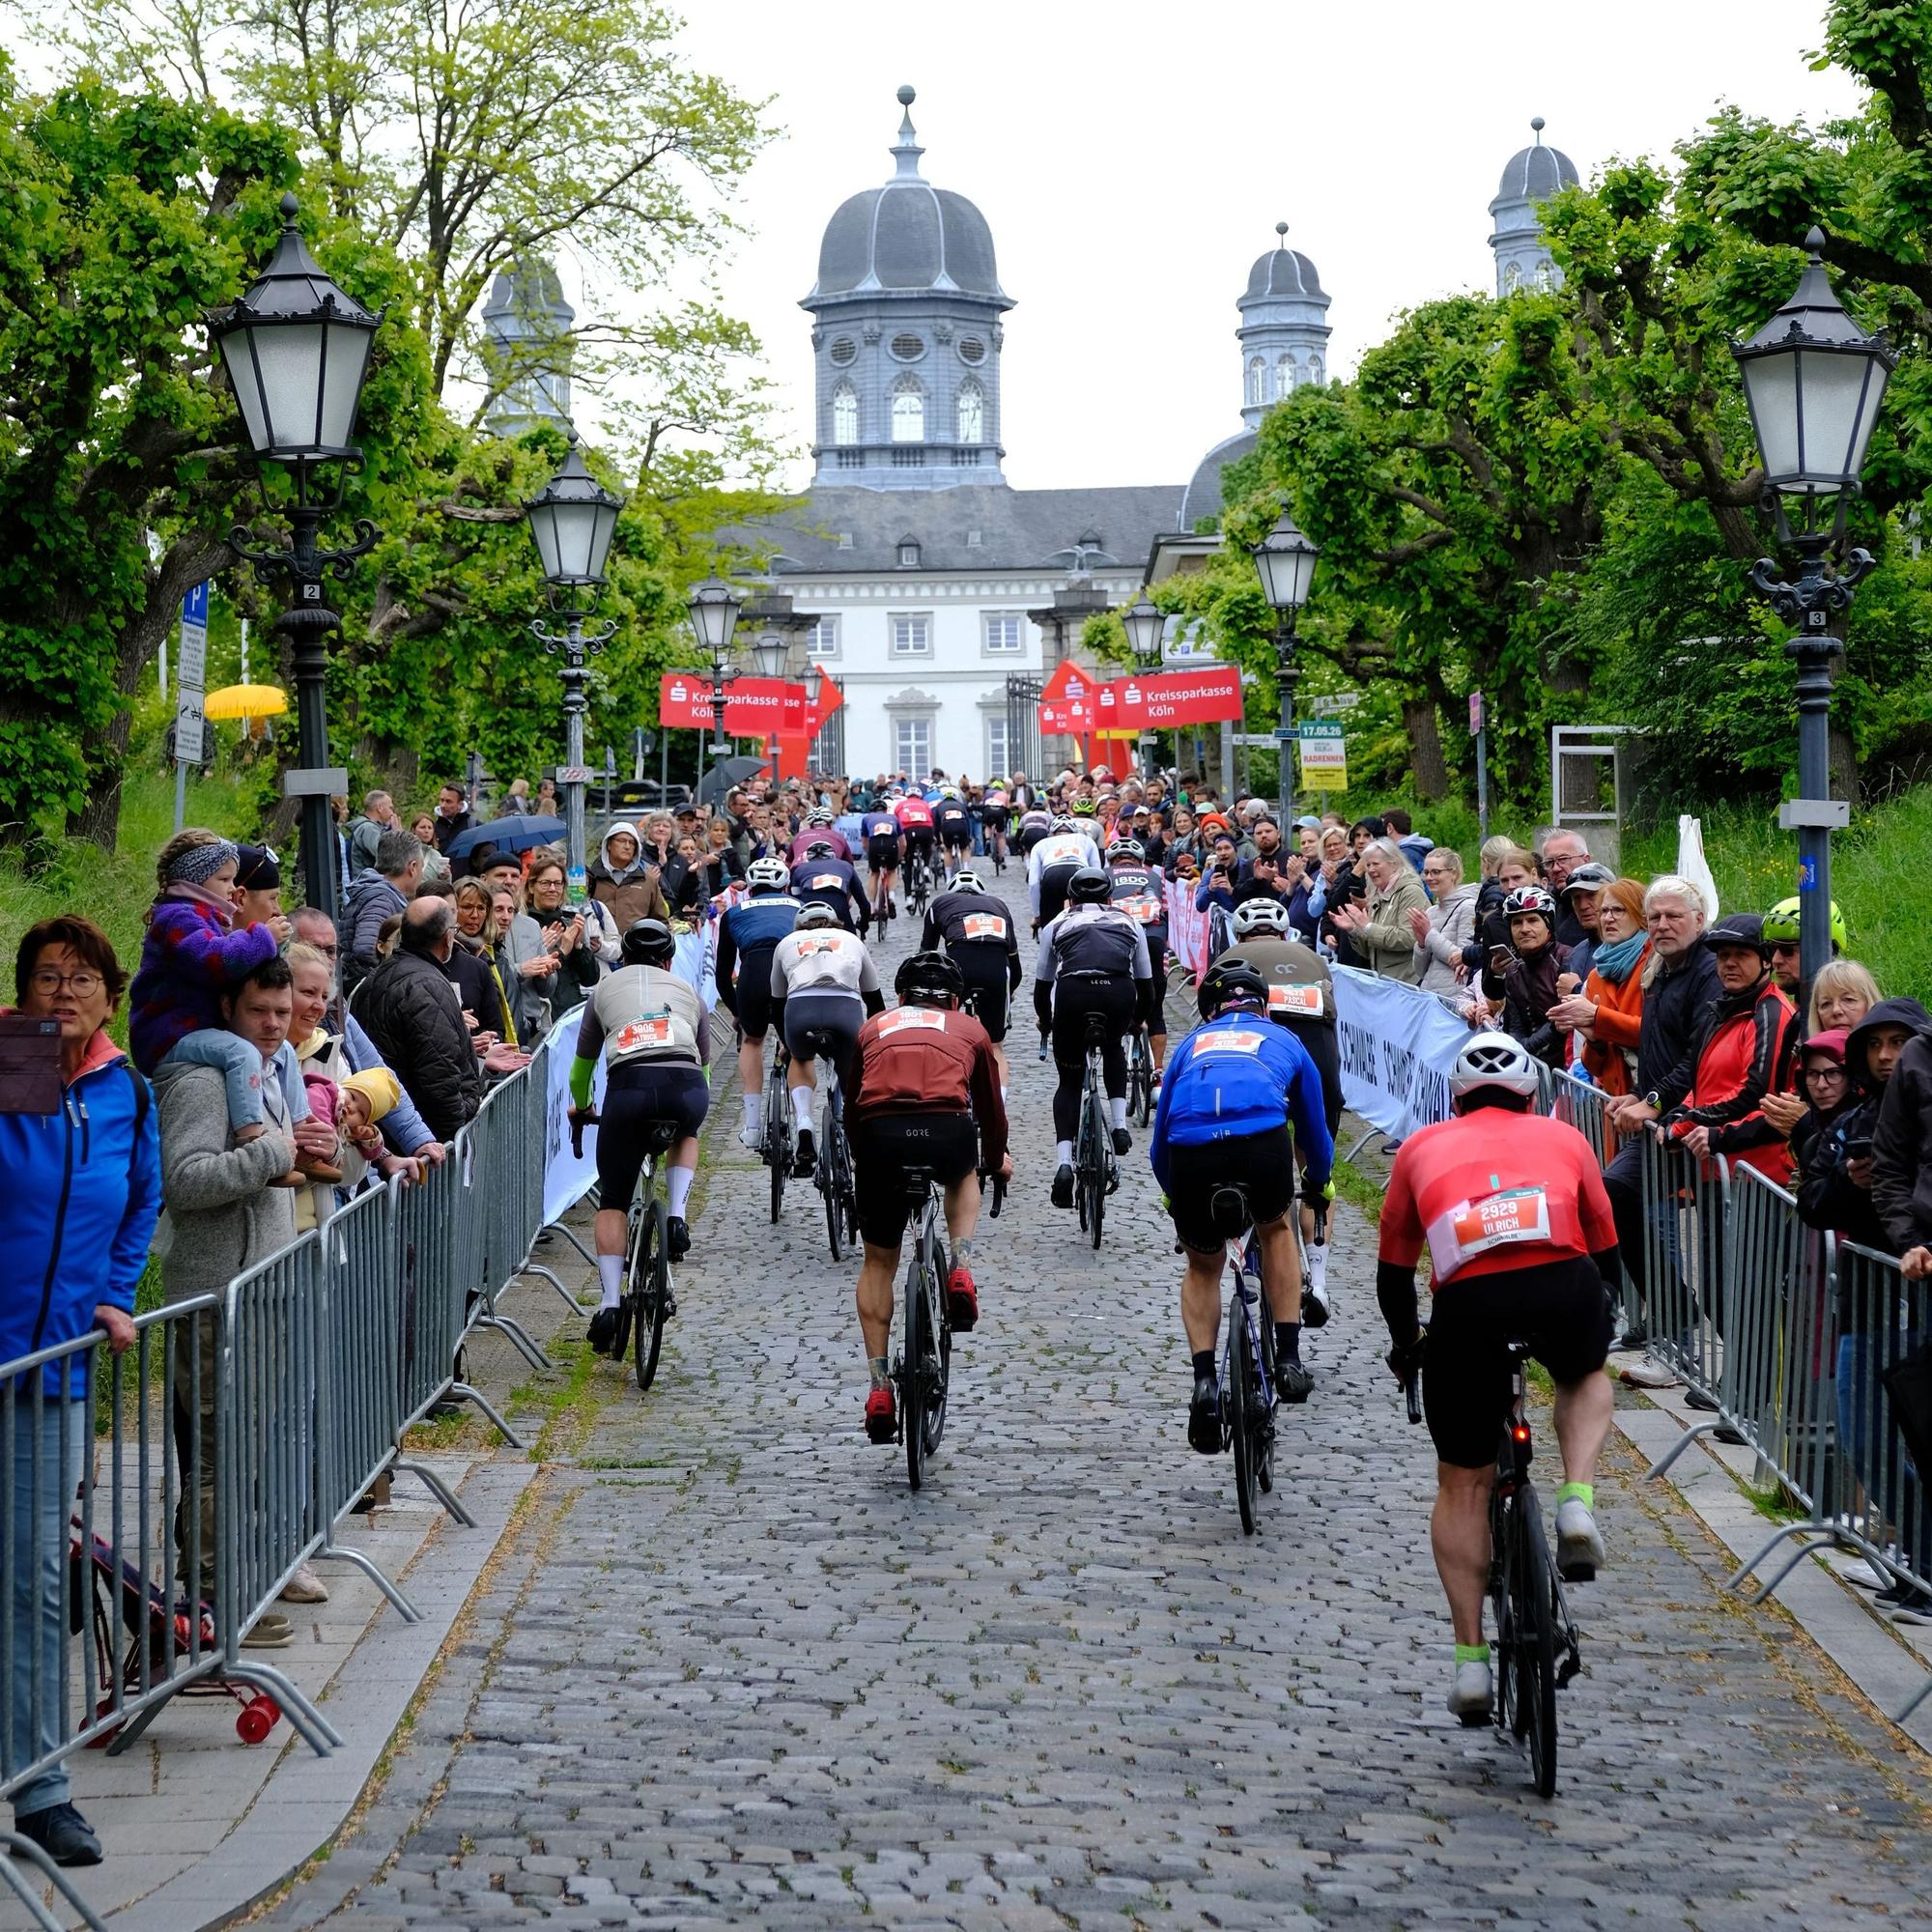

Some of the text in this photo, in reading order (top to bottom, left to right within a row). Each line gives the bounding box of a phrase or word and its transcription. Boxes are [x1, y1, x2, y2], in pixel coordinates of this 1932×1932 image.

[307, 586, 317, 598] 2
[1812, 611, 1822, 624] 3
[692, 692, 779, 706] Kreparkasse
[1147, 686, 1233, 702] Kreissparkasse
[1148, 704, 1175, 718] Köln
[1302, 725, 1342, 736] 17.05.26
[1283, 995, 1307, 1006] PASCAL
[905, 1128, 930, 1137] GORE
[1481, 1201, 1518, 1222] 2929
[1483, 1216, 1520, 1236] ULRICH
